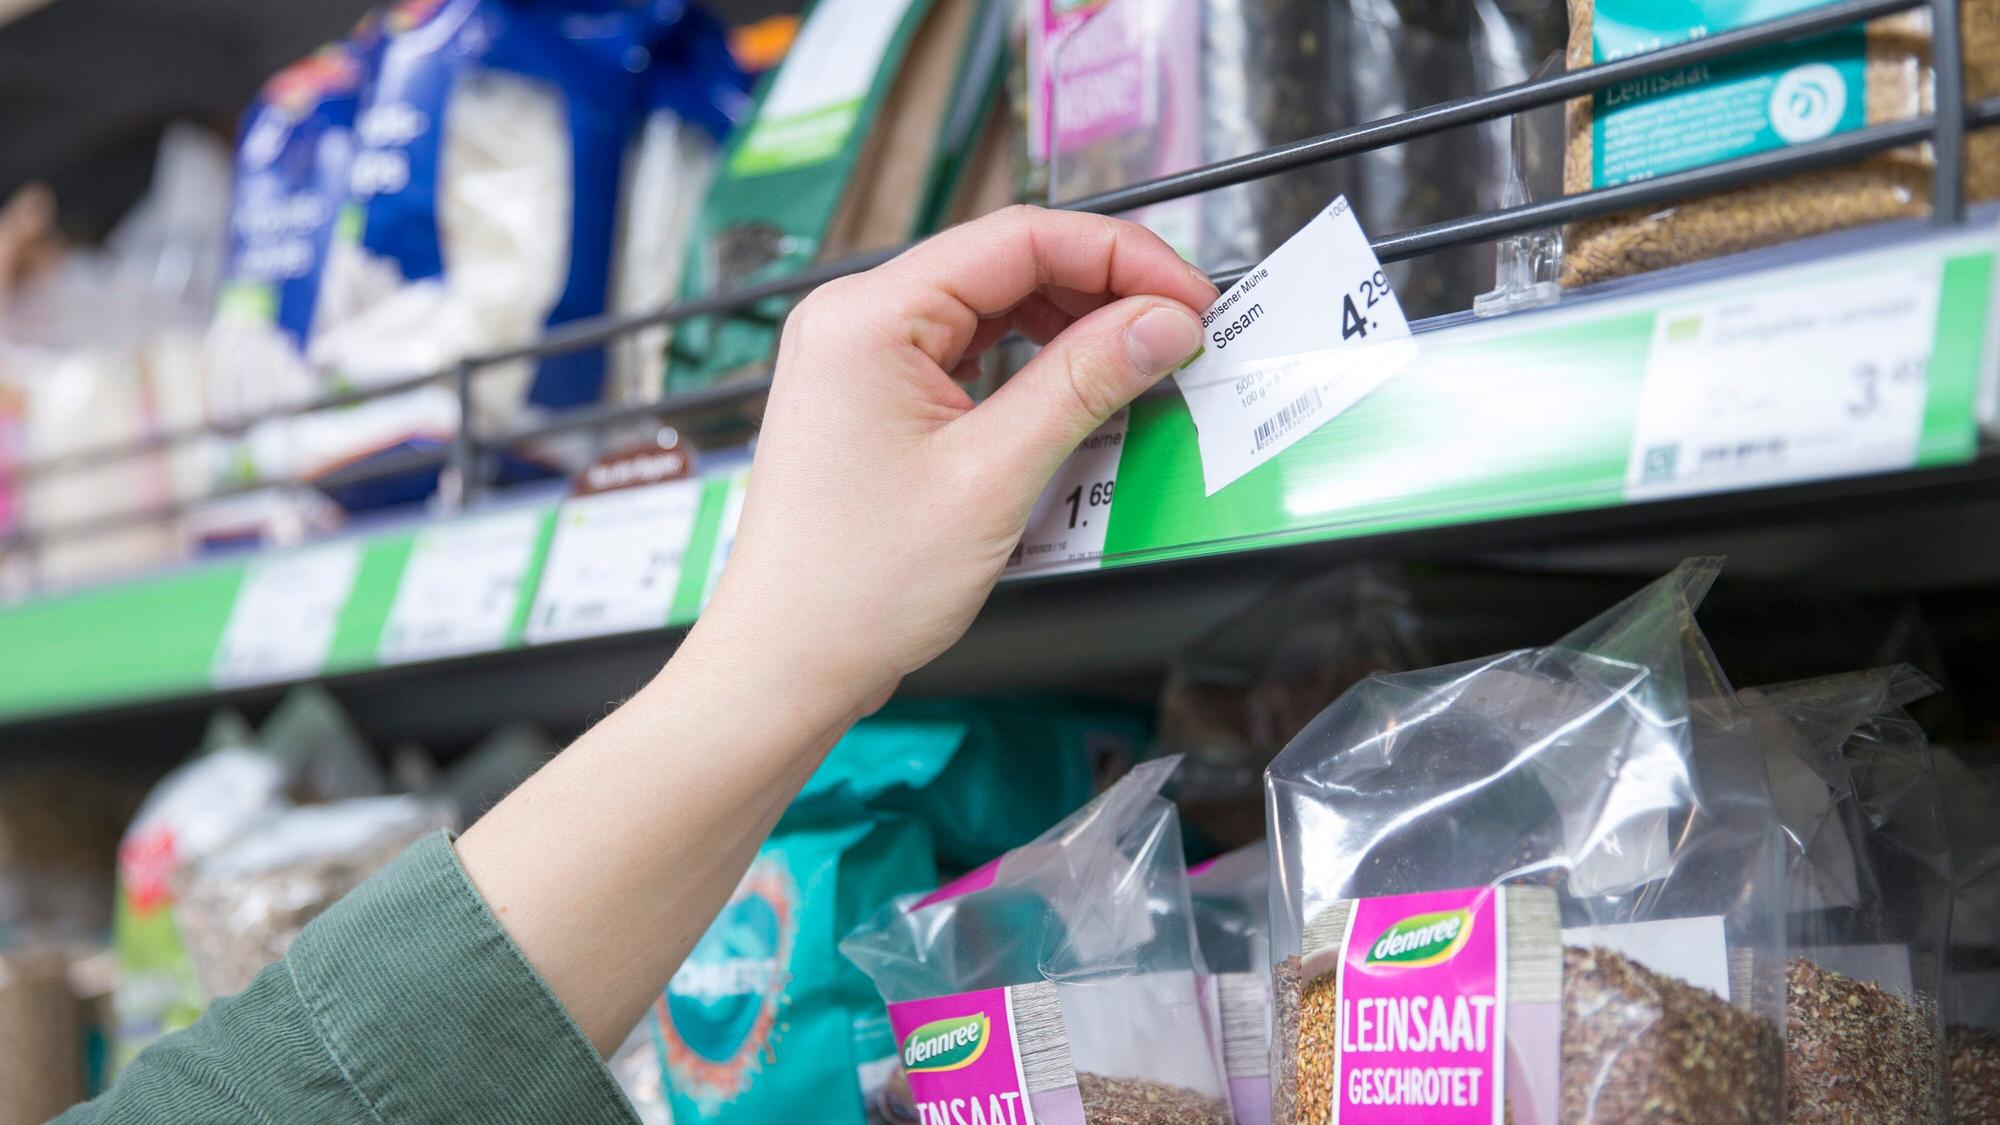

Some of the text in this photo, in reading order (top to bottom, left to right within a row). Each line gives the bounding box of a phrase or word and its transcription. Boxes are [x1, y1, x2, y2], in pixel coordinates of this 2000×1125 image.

[1201, 269, 1269, 328] Bohlsener Mühle
[1212, 303, 1264, 349] Sesam
[1235, 374, 1254, 395] 500
[1374, 917, 1461, 960] dennree
[904, 1021, 979, 1067] dennree
[1343, 995, 1495, 1053] LEINSAAT
[1349, 1067, 1483, 1107] GESCHROTET
